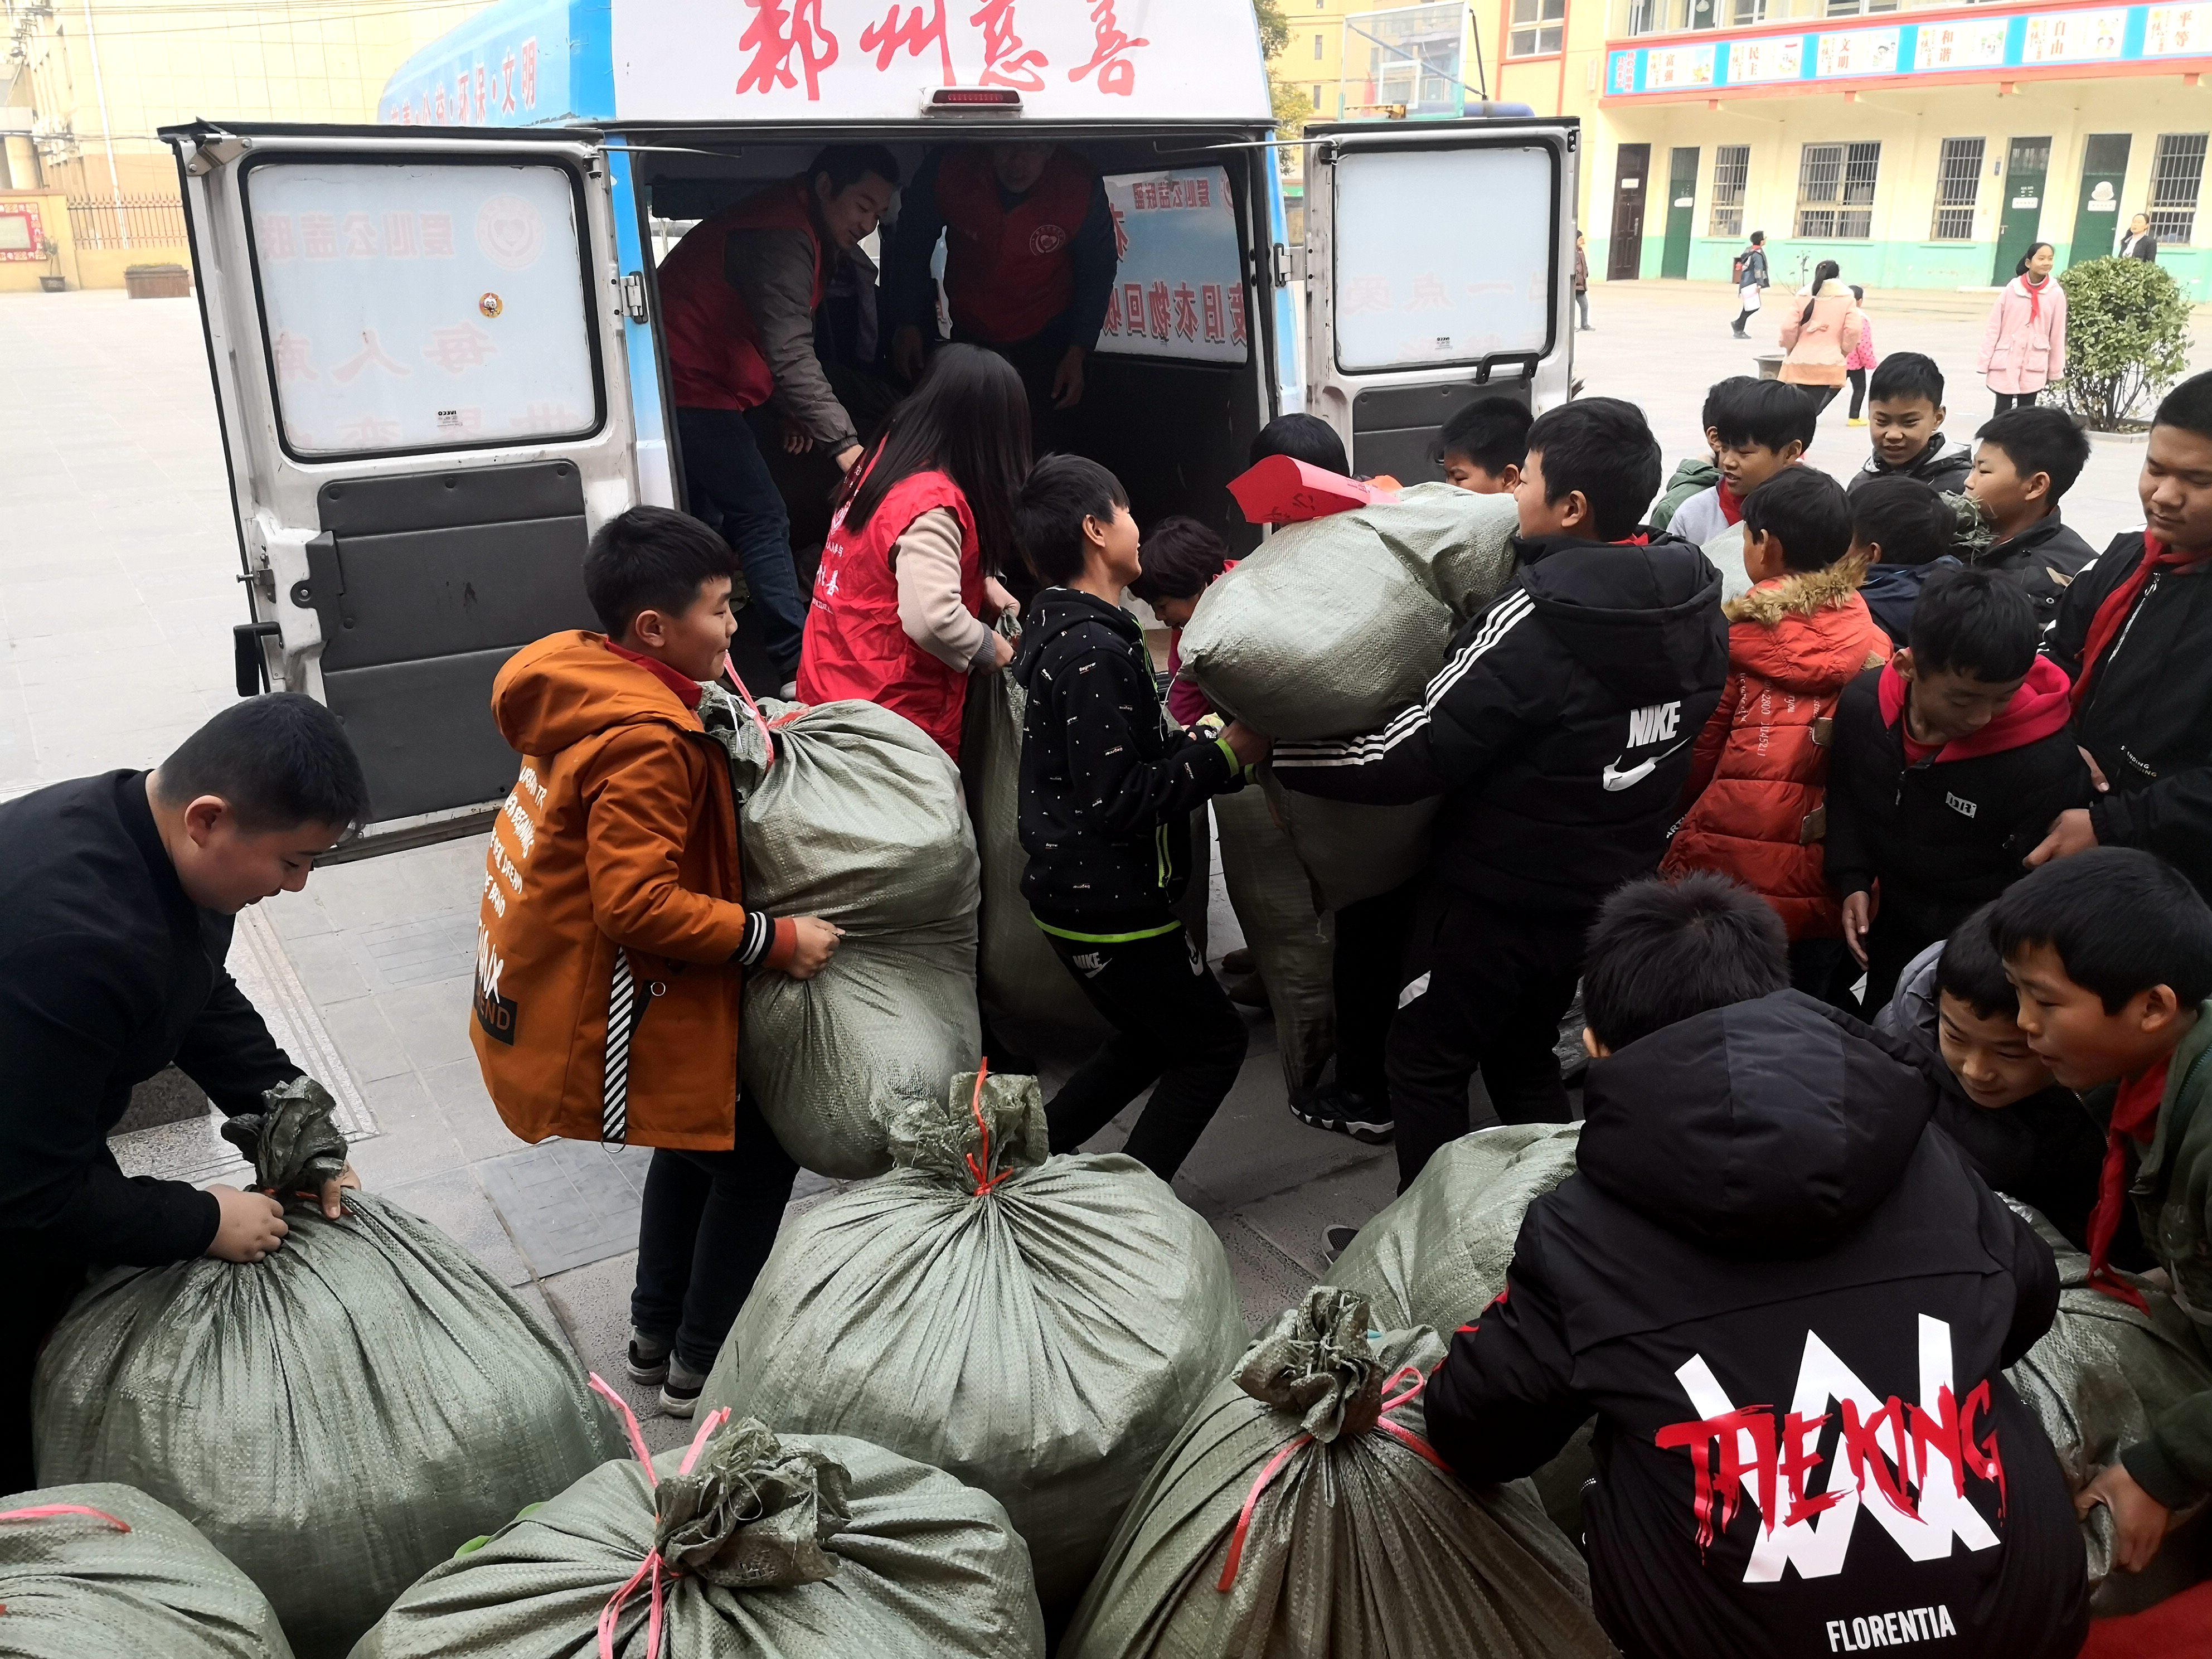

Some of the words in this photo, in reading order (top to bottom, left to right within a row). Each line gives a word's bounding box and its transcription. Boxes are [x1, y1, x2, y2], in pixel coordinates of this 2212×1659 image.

[2175, 10, 2192, 47] 平等
[1837, 38, 1851, 69] 文明
[1939, 30, 1954, 62] 和谐
[1665, 54, 1675, 81] 富强
[1749, 47, 1759, 75] 民主
[1079, 662, 1097, 672] Beginner
[1761, 693, 1772, 715] 2800
[1626, 700, 1681, 749] NIKE
[1105, 746, 1123, 756] Beginner
[1185, 761, 1194, 779] Beginner
[501, 853, 523, 895] DREAM
[1073, 952, 1100, 969] NIKE
[1841, 1379, 2006, 1527] KING
[1826, 1605, 1957, 1652] FLORENTIA
